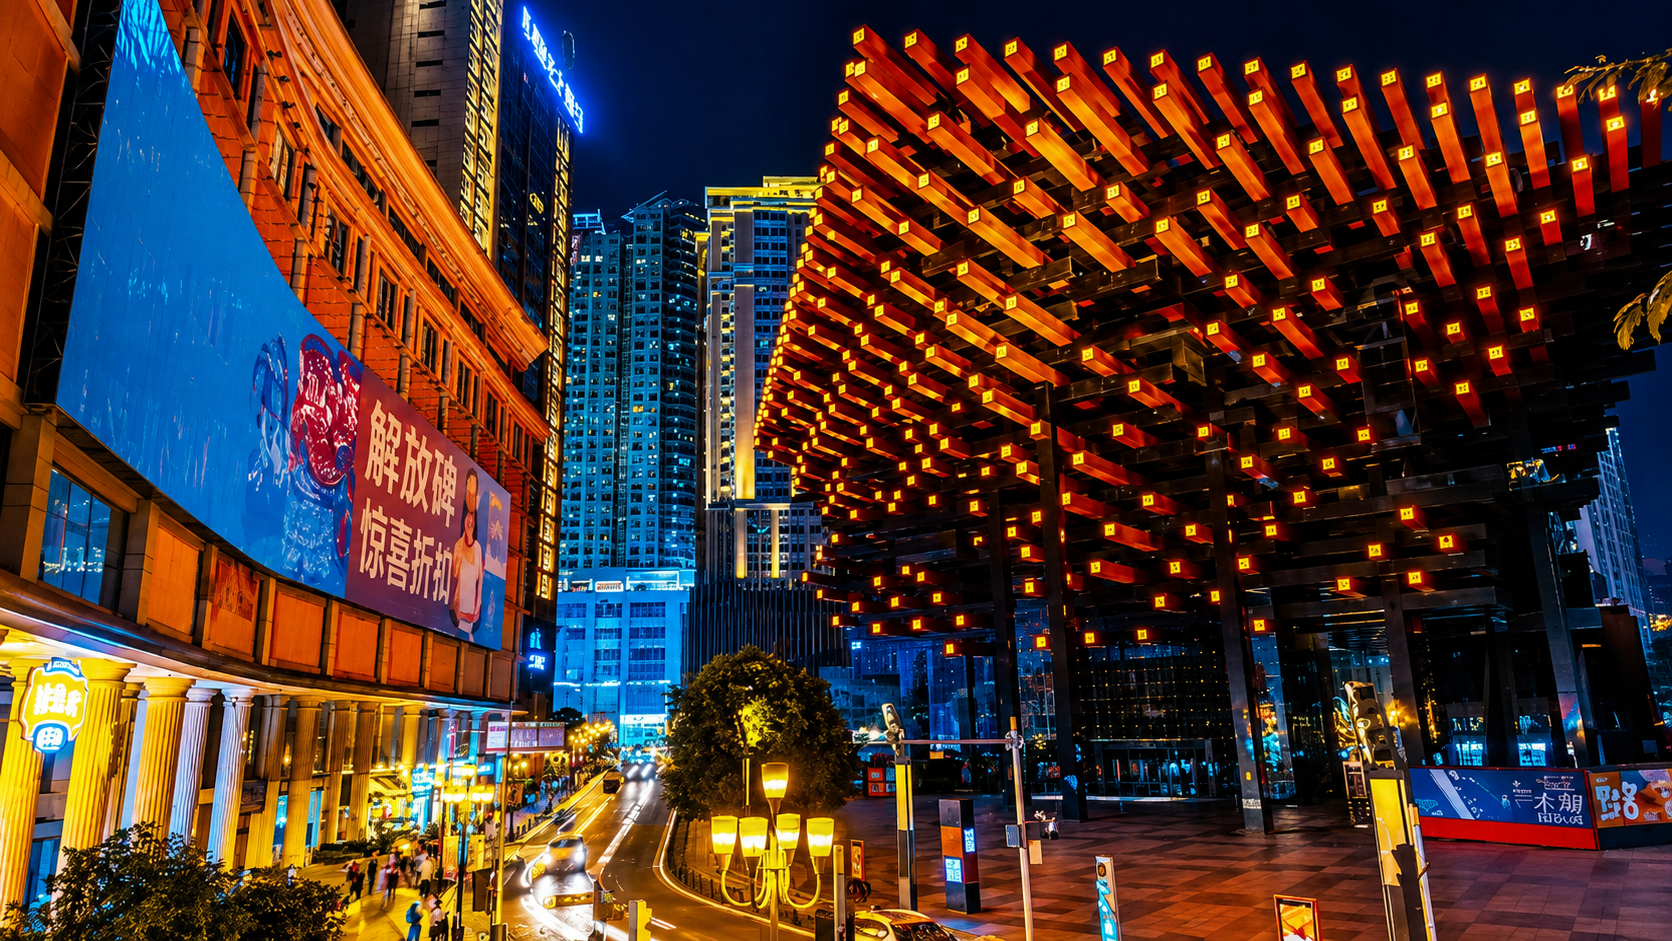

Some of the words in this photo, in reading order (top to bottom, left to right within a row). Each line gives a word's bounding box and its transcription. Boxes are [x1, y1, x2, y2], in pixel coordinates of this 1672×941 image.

[364, 399, 458, 528] 解放碑
[359, 497, 453, 605] 惊喜折扣
